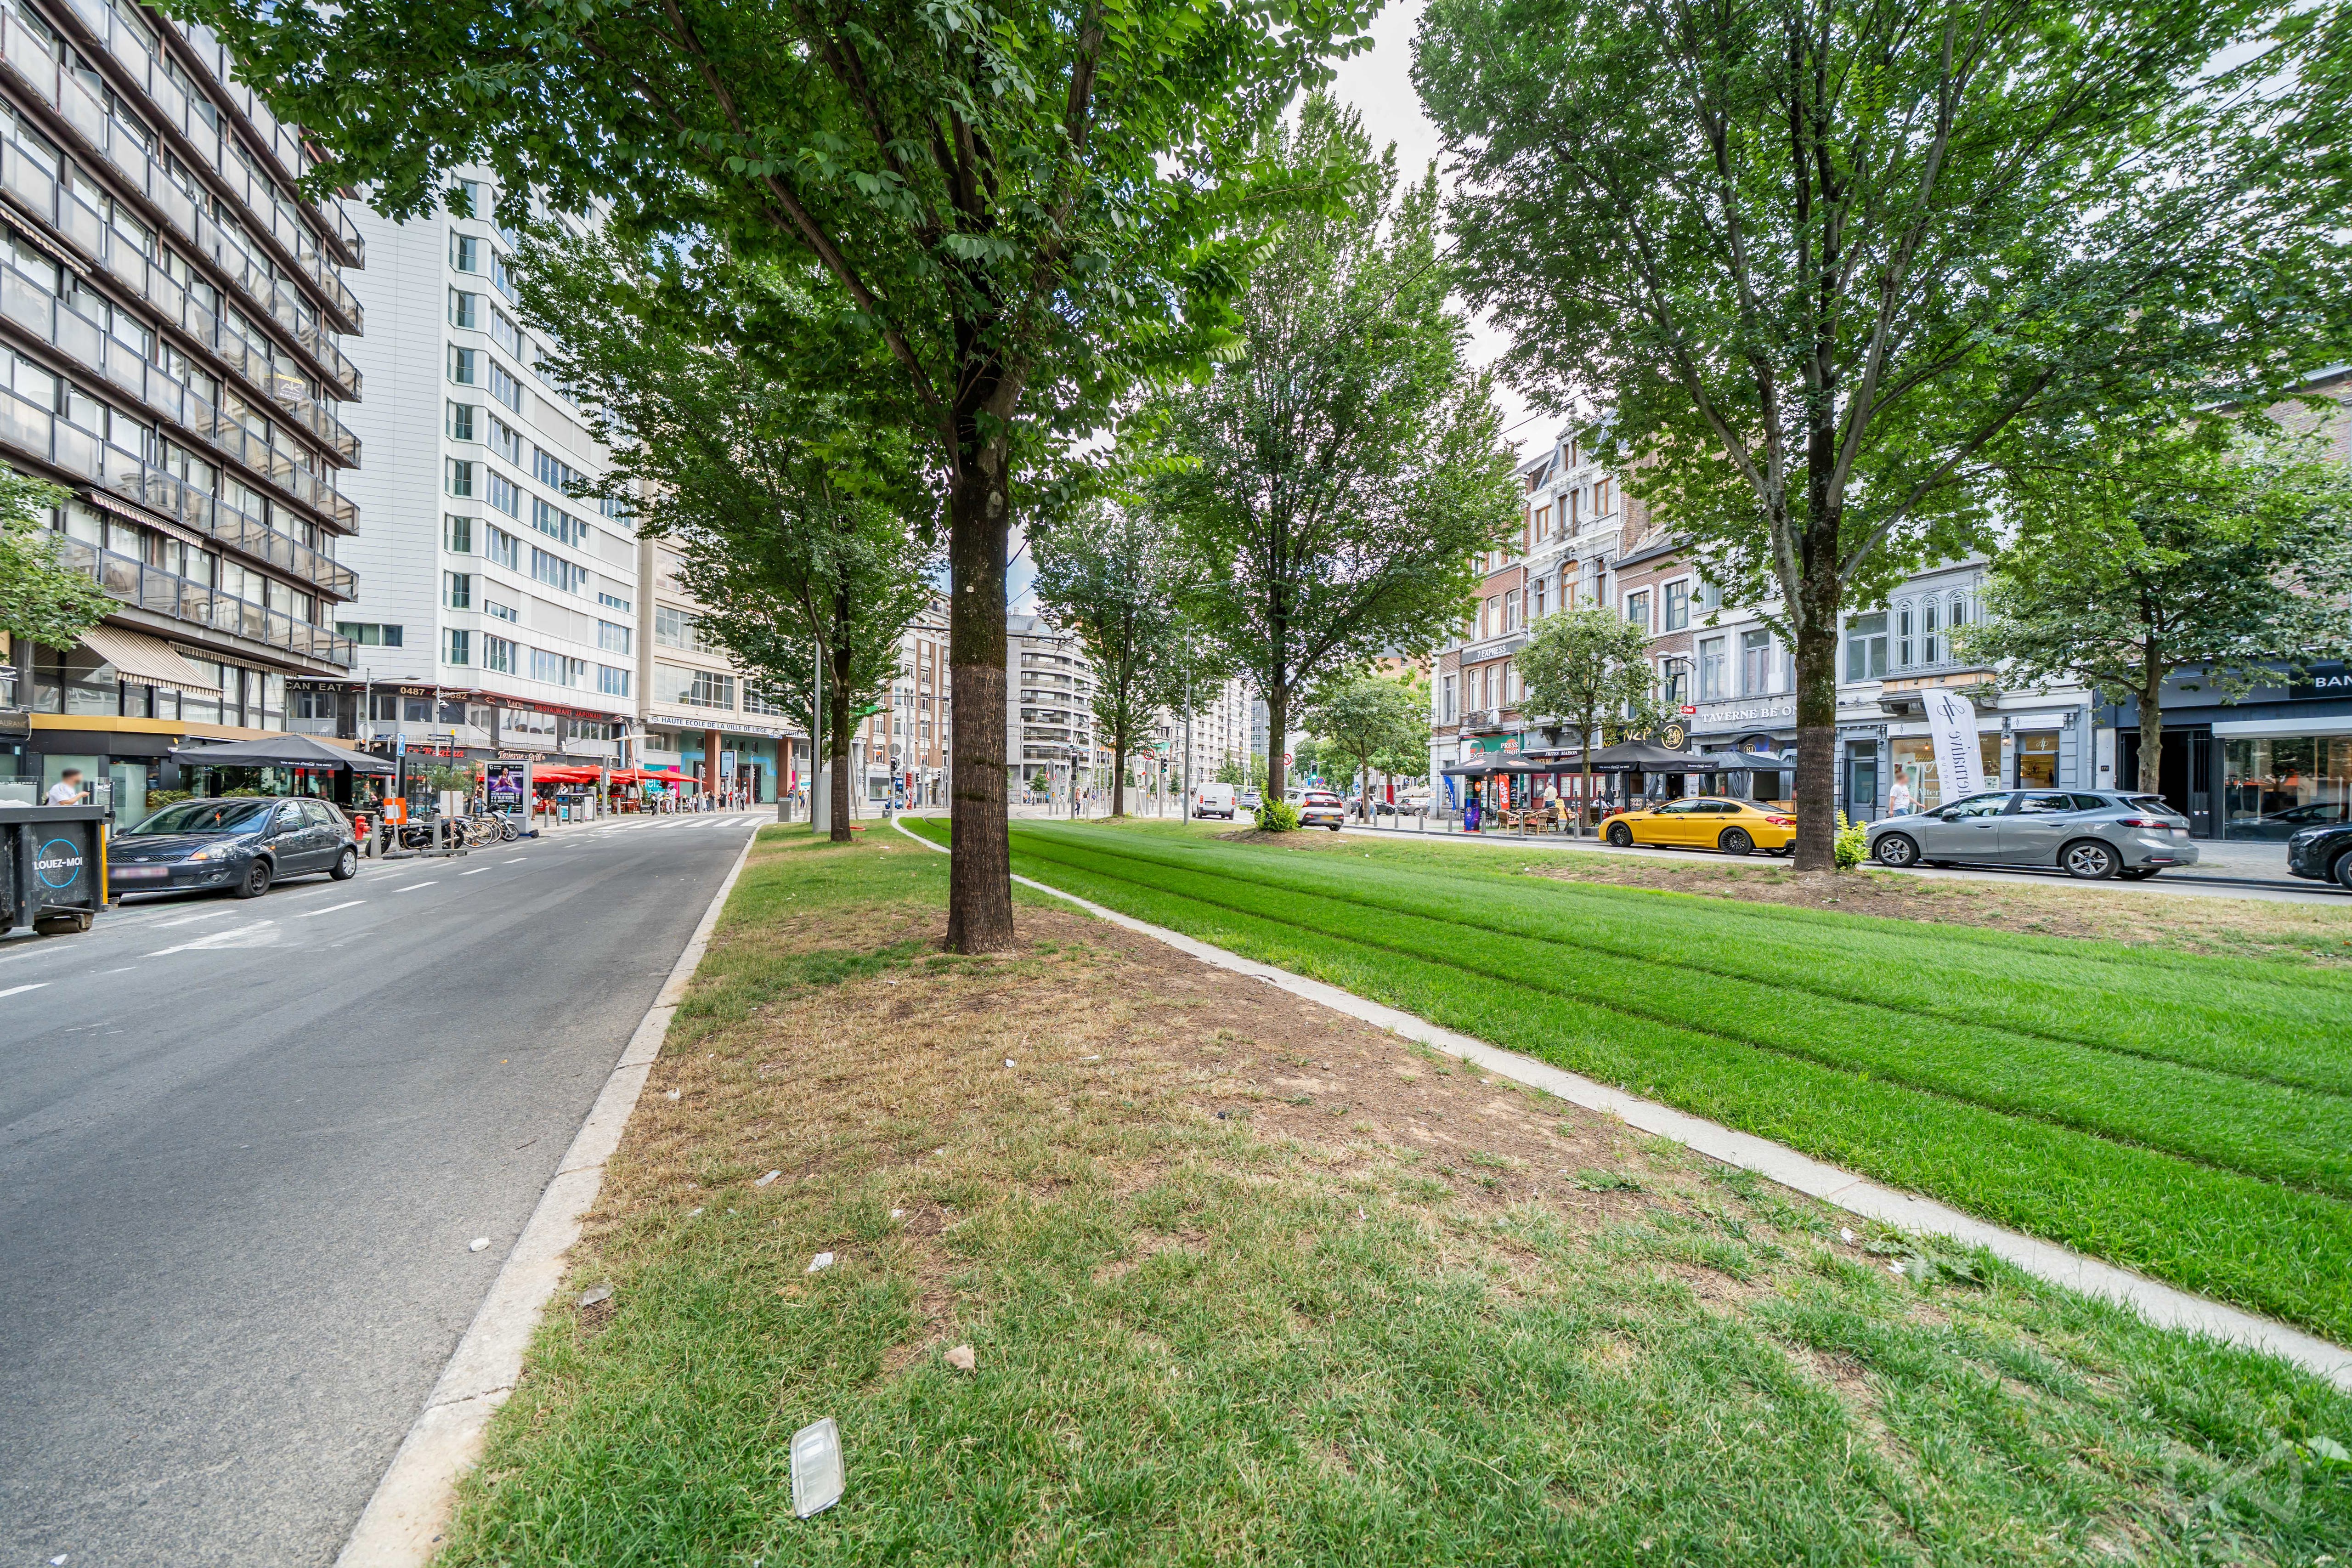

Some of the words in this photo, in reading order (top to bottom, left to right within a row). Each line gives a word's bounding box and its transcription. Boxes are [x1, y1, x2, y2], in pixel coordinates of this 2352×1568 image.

[1481, 645, 1506, 658] EXPRESS
[285, 682, 311, 690] CAN
[319, 683, 343, 691] EAT
[400, 687, 425, 696] 0487
[534, 704, 572, 716] RESTAURANT
[1702, 709, 1757, 723] TAVERNE
[1761, 707, 1778, 718] BE
[399, 736, 404, 747] P
[528, 753, 543, 762] Grill
[33, 857, 83, 870] LOUEZ-MOI
